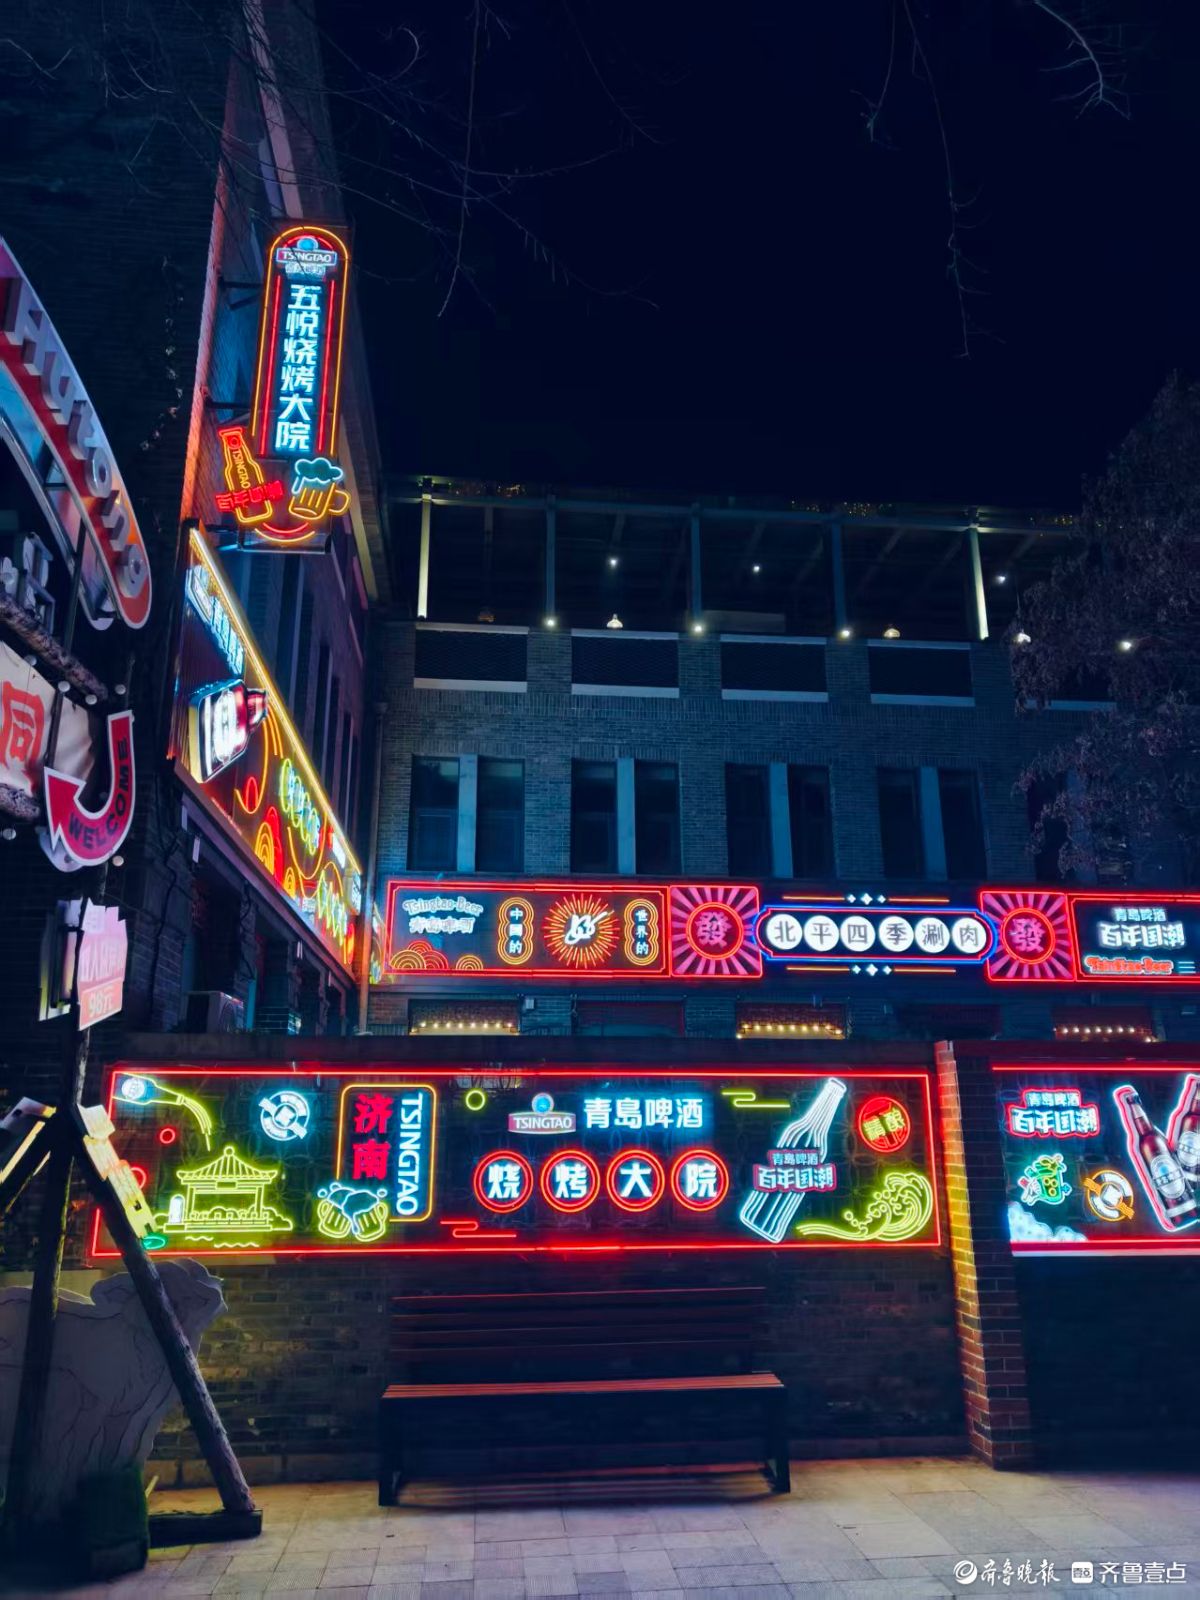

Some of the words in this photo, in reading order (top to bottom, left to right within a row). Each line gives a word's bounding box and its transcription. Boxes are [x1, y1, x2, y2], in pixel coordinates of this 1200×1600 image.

[282, 251, 332, 264] TSNGTAO
[275, 284, 321, 450] 五悦烧烤大院
[231, 449, 251, 489] TSINGTAO
[67, 737, 130, 850] WELCOME
[635, 909, 649, 954] 世界的
[773, 919, 980, 947] 北平四季涮肉
[1100, 922, 1185, 948] 百年国潮
[512, 1116, 572, 1130] TSINGTAO
[584, 1097, 703, 1130] 青岛啤酒
[1011, 1108, 1097, 1134] 百年国潮
[352, 1093, 394, 1180] 济南
[395, 1092, 423, 1216] TSINGTAO
[487, 1162, 718, 1200] 烧烤大院
[758, 1165, 834, 1189] 百年国潮
